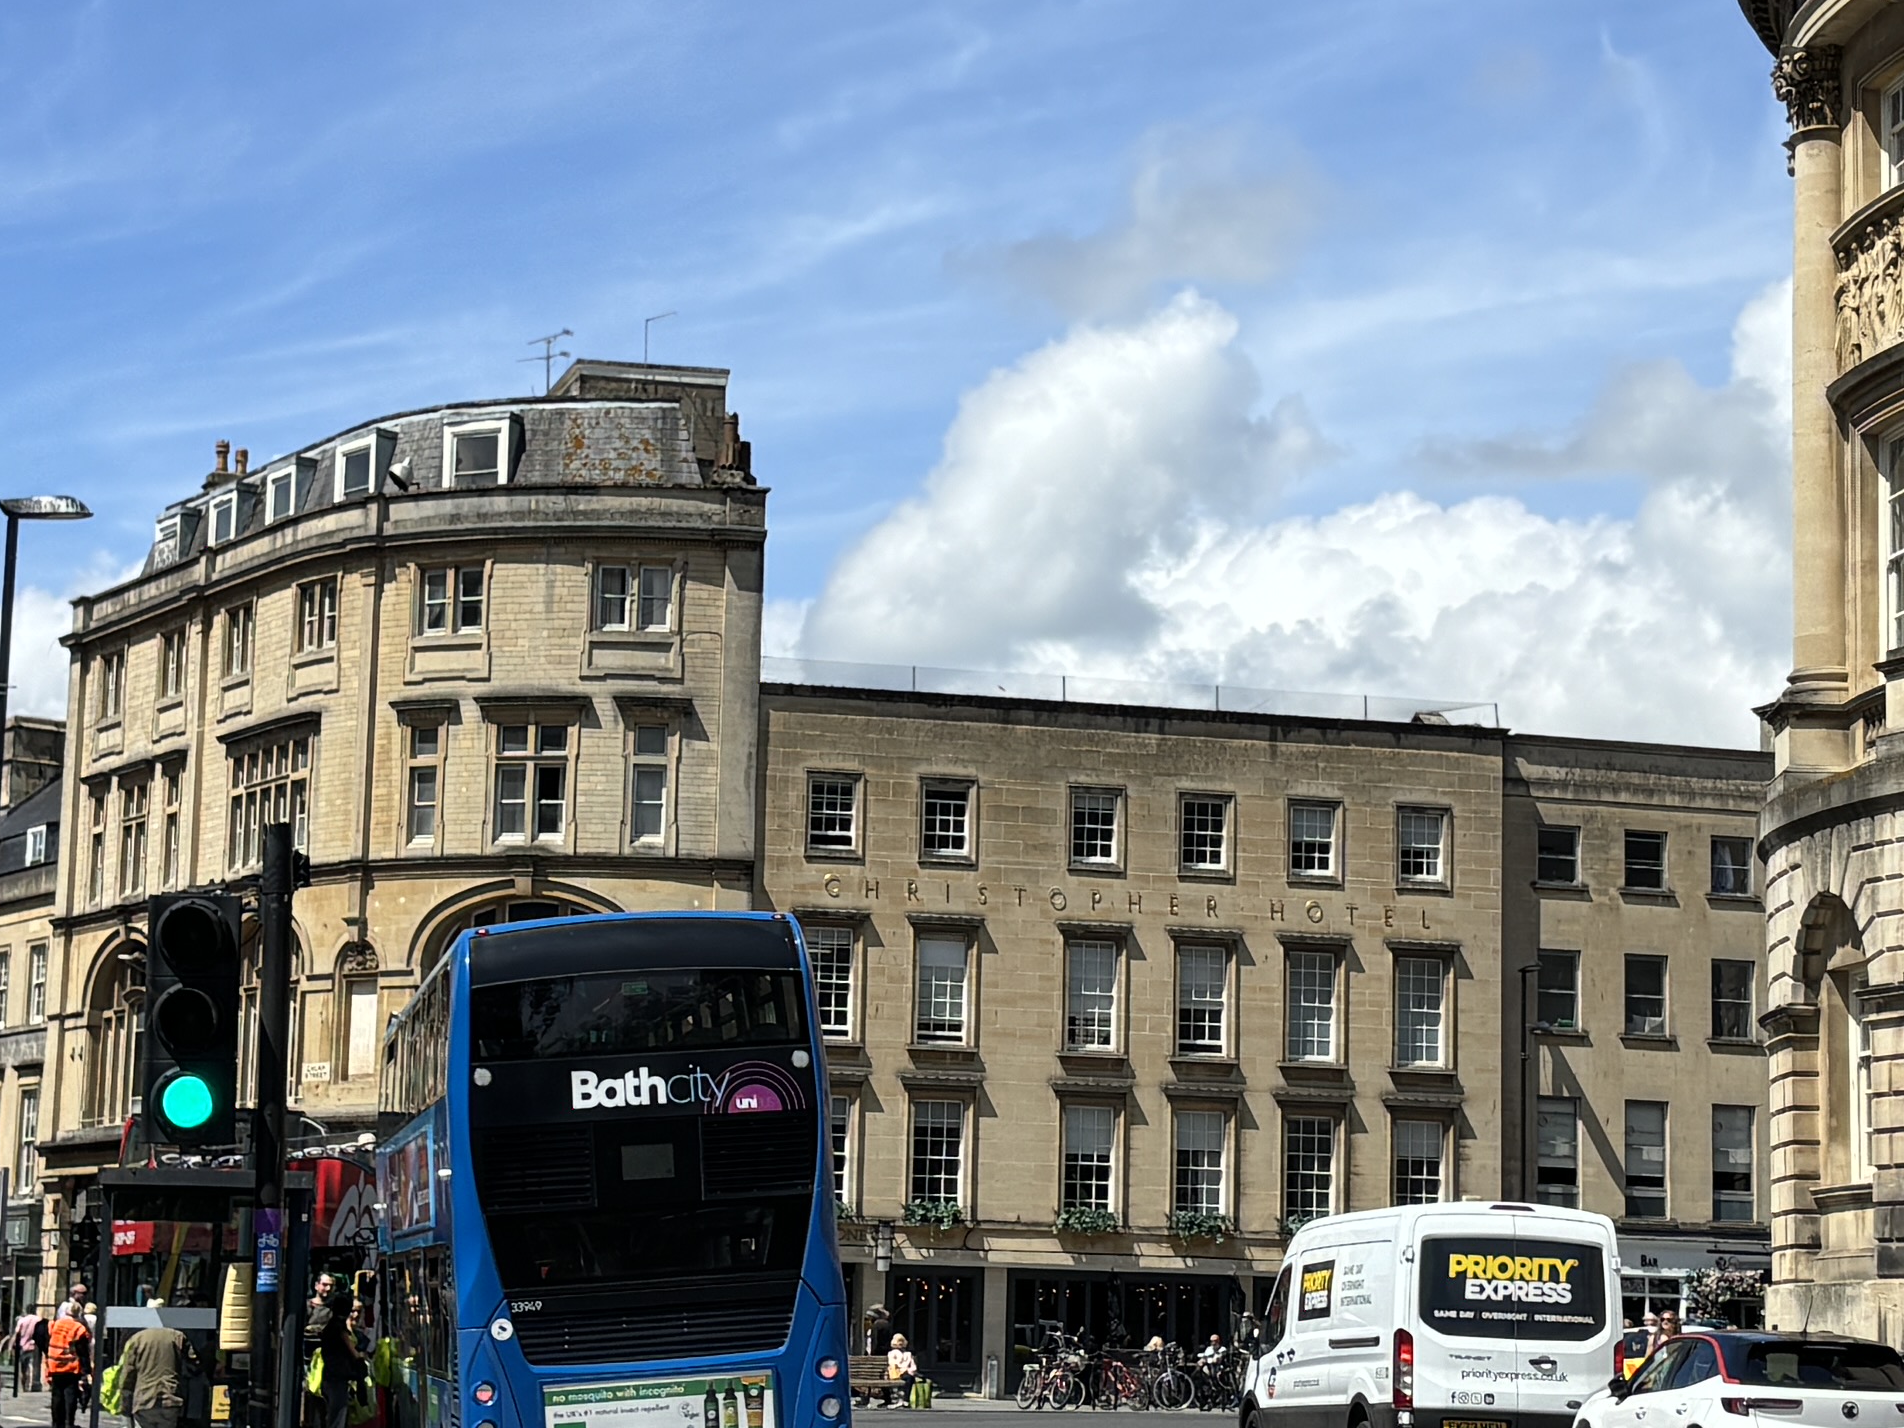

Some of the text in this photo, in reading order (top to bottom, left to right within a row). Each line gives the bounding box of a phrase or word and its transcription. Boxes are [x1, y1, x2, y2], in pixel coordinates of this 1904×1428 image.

[824, 874, 1430, 929] CHRISTOPHER HOTEL
[1465, 1279, 1572, 1304] EXPRESS
[511, 1301, 543, 1313] 33949
[552, 1395, 565, 1403] no
[568, 1390, 613, 1403] mosquito
[616, 1387, 637, 1397] with
